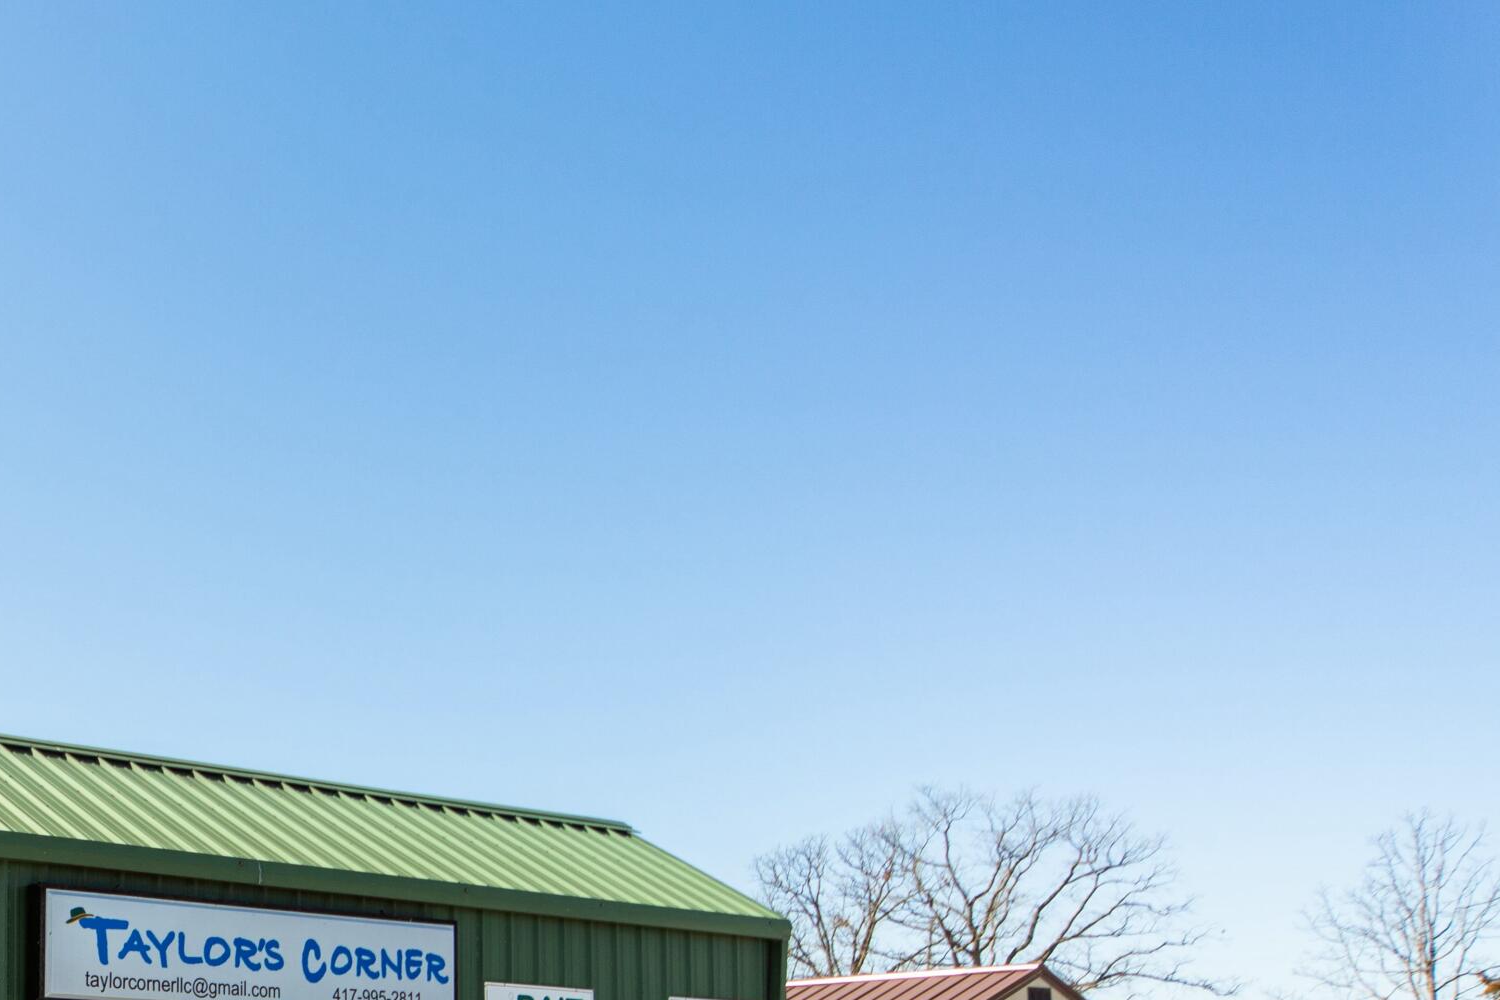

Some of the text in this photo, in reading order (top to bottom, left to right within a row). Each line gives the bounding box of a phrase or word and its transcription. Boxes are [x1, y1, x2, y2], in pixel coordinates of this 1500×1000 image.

[79, 916, 450, 985] TAYLOR'S CORNER
[85, 971, 281, 1000] taylorcornerllc@gmail.com
